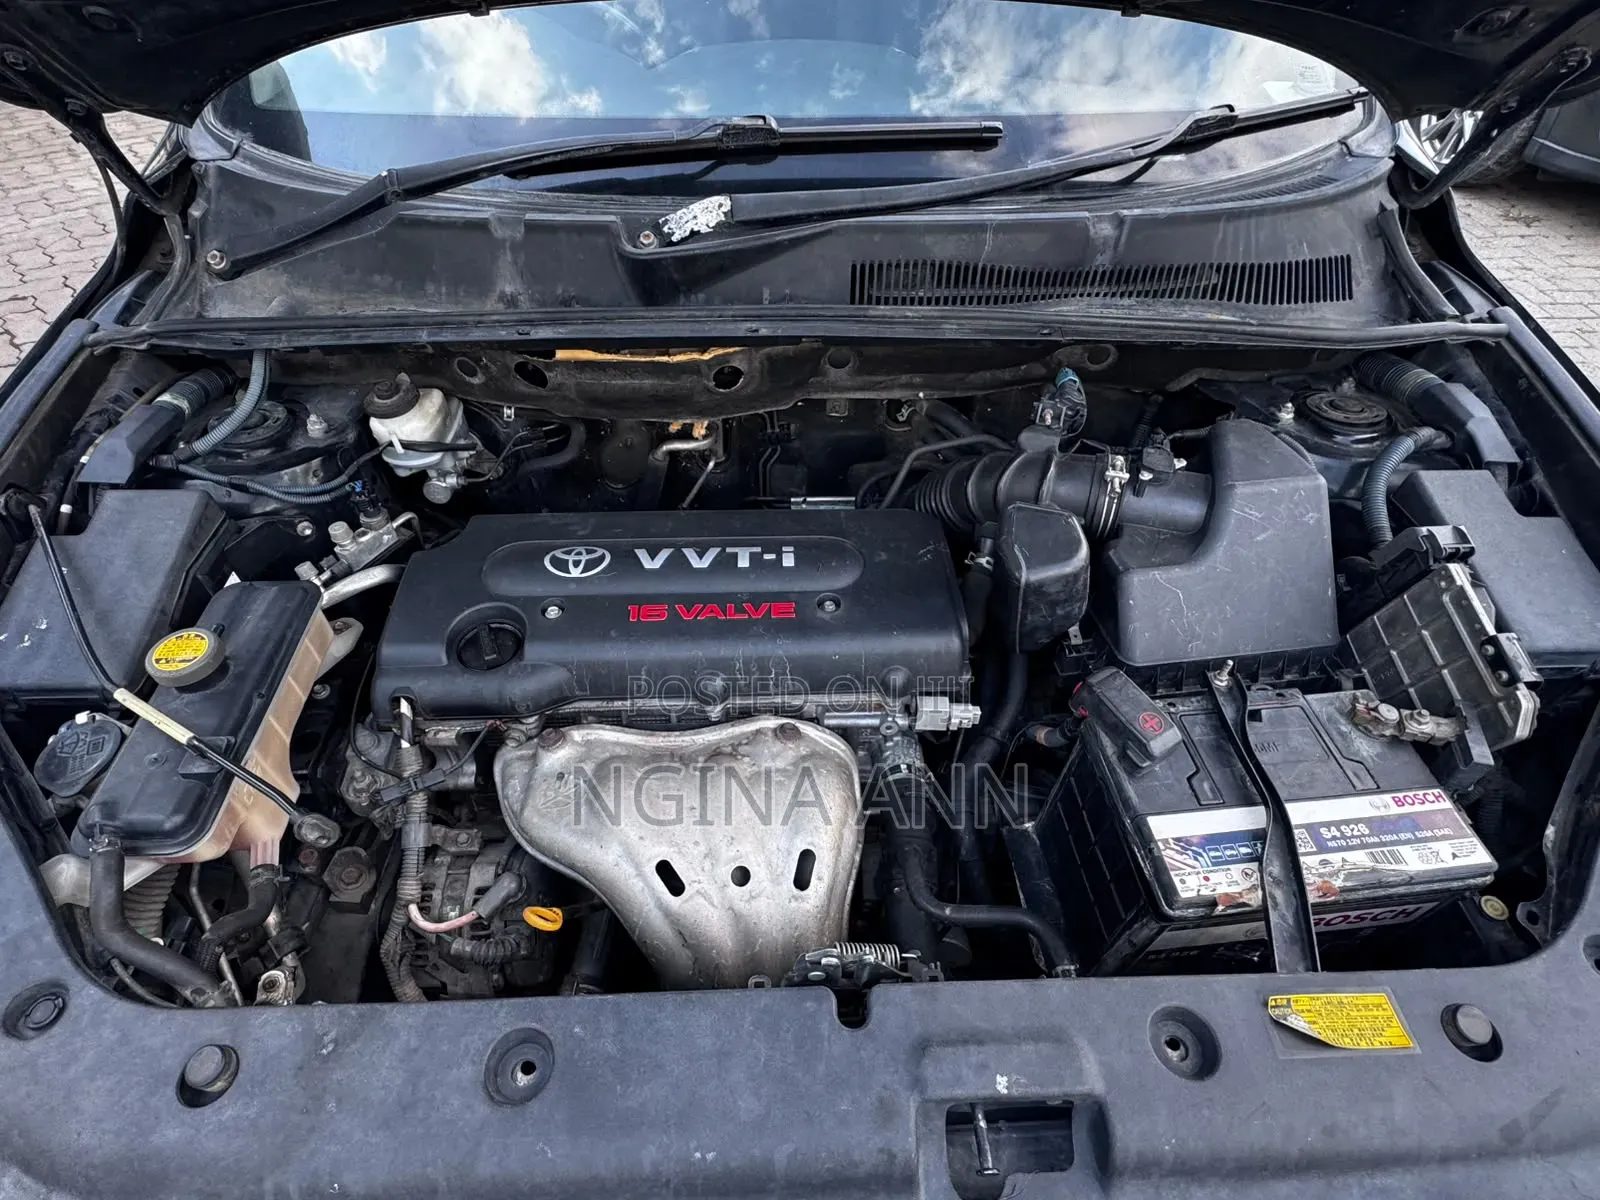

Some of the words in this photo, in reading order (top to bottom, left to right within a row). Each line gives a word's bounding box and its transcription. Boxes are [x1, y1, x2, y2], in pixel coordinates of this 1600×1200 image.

[633, 546, 795, 569] VVT-i
[628, 604, 668, 622] 16
[675, 602, 796, 620] VALVE
[1391, 791, 1446, 808] BOSCH
[1319, 825, 1341, 840] S4
[1347, 837, 1361, 846] 12V
[1361, 835, 1381, 845] 70Ah
